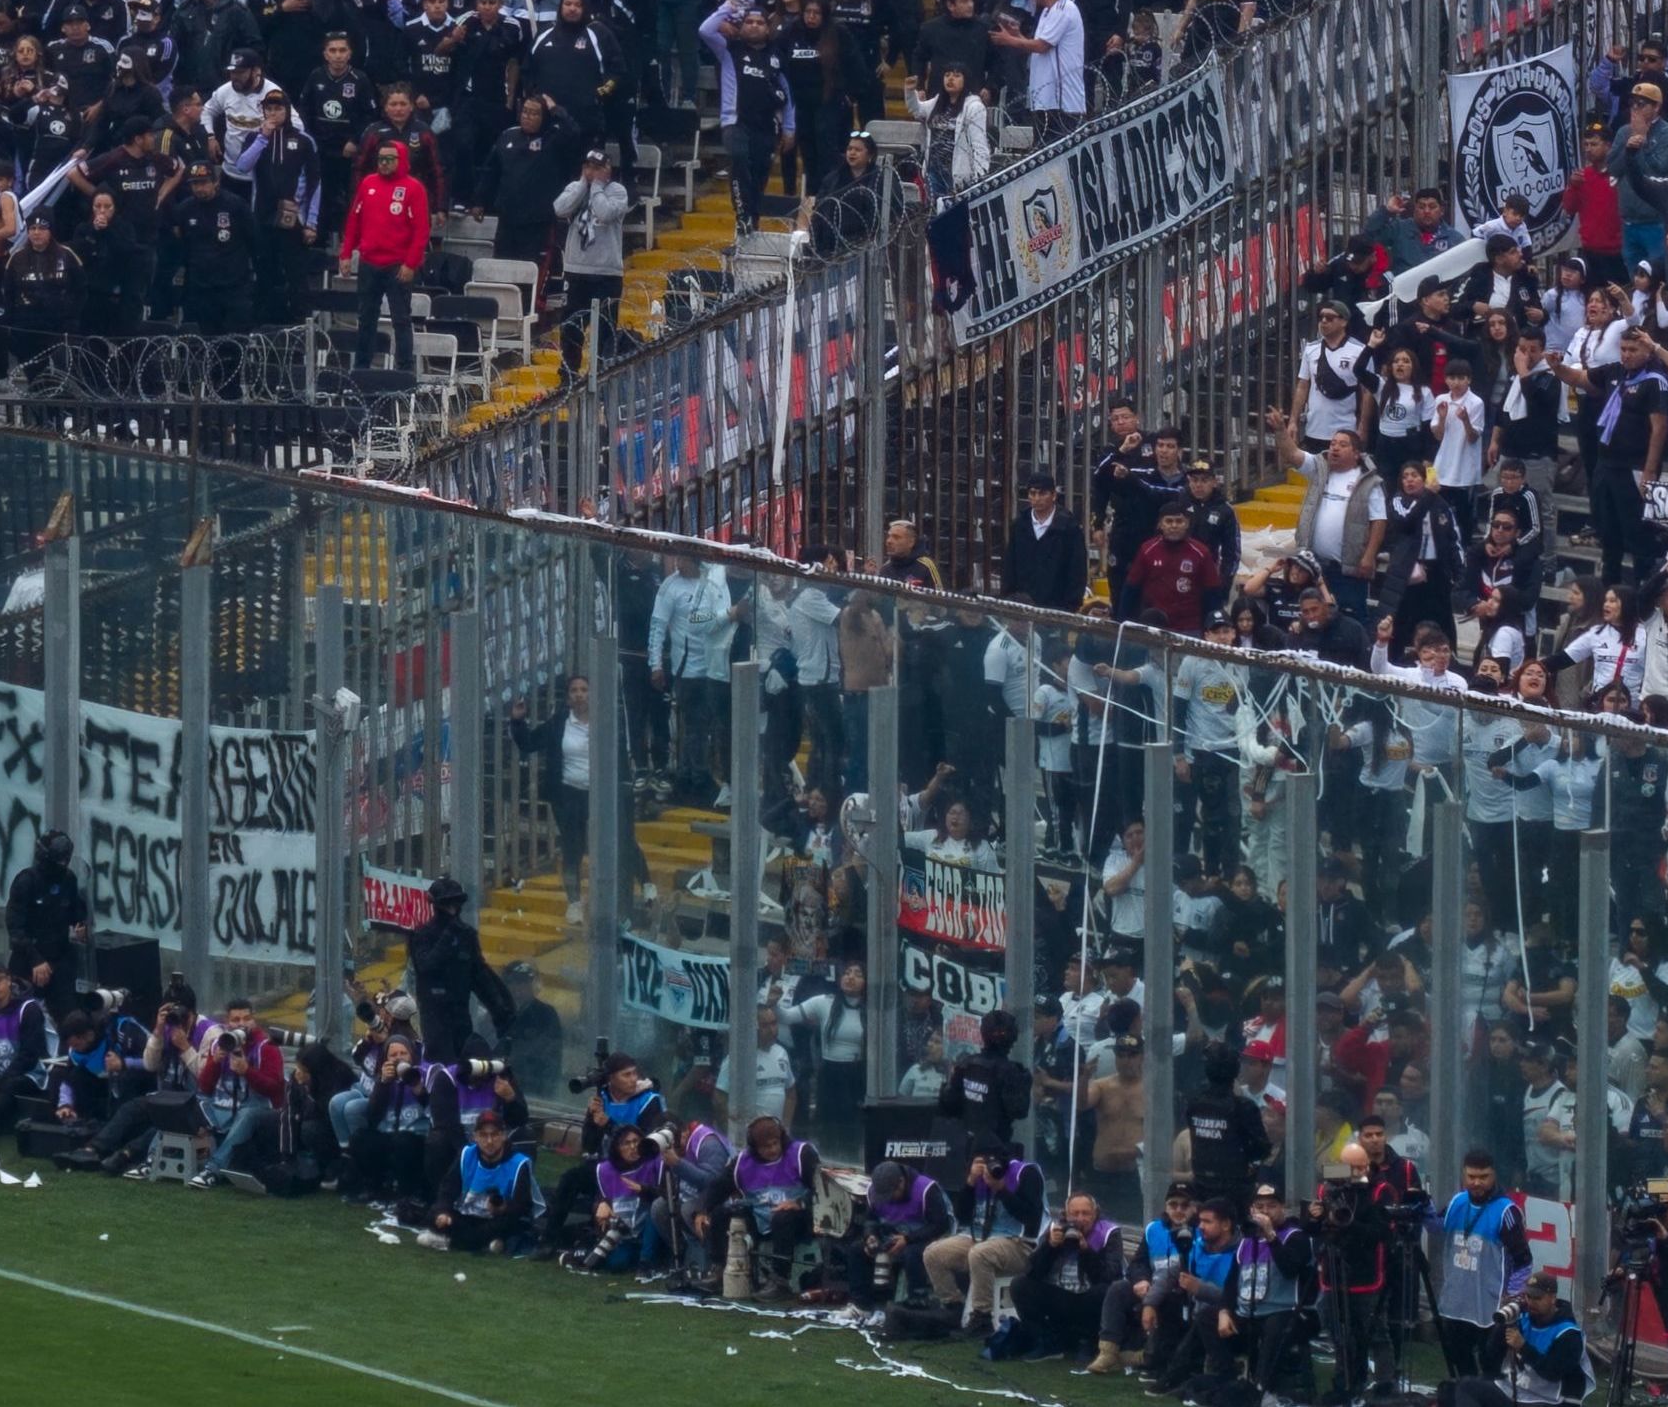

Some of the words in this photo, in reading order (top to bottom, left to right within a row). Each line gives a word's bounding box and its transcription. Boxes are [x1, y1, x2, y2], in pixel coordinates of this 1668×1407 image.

[968, 193, 1019, 319] HE
[1067, 78, 1227, 261] ISLADICTOS
[1500, 173, 1563, 203] COLO-COLO
